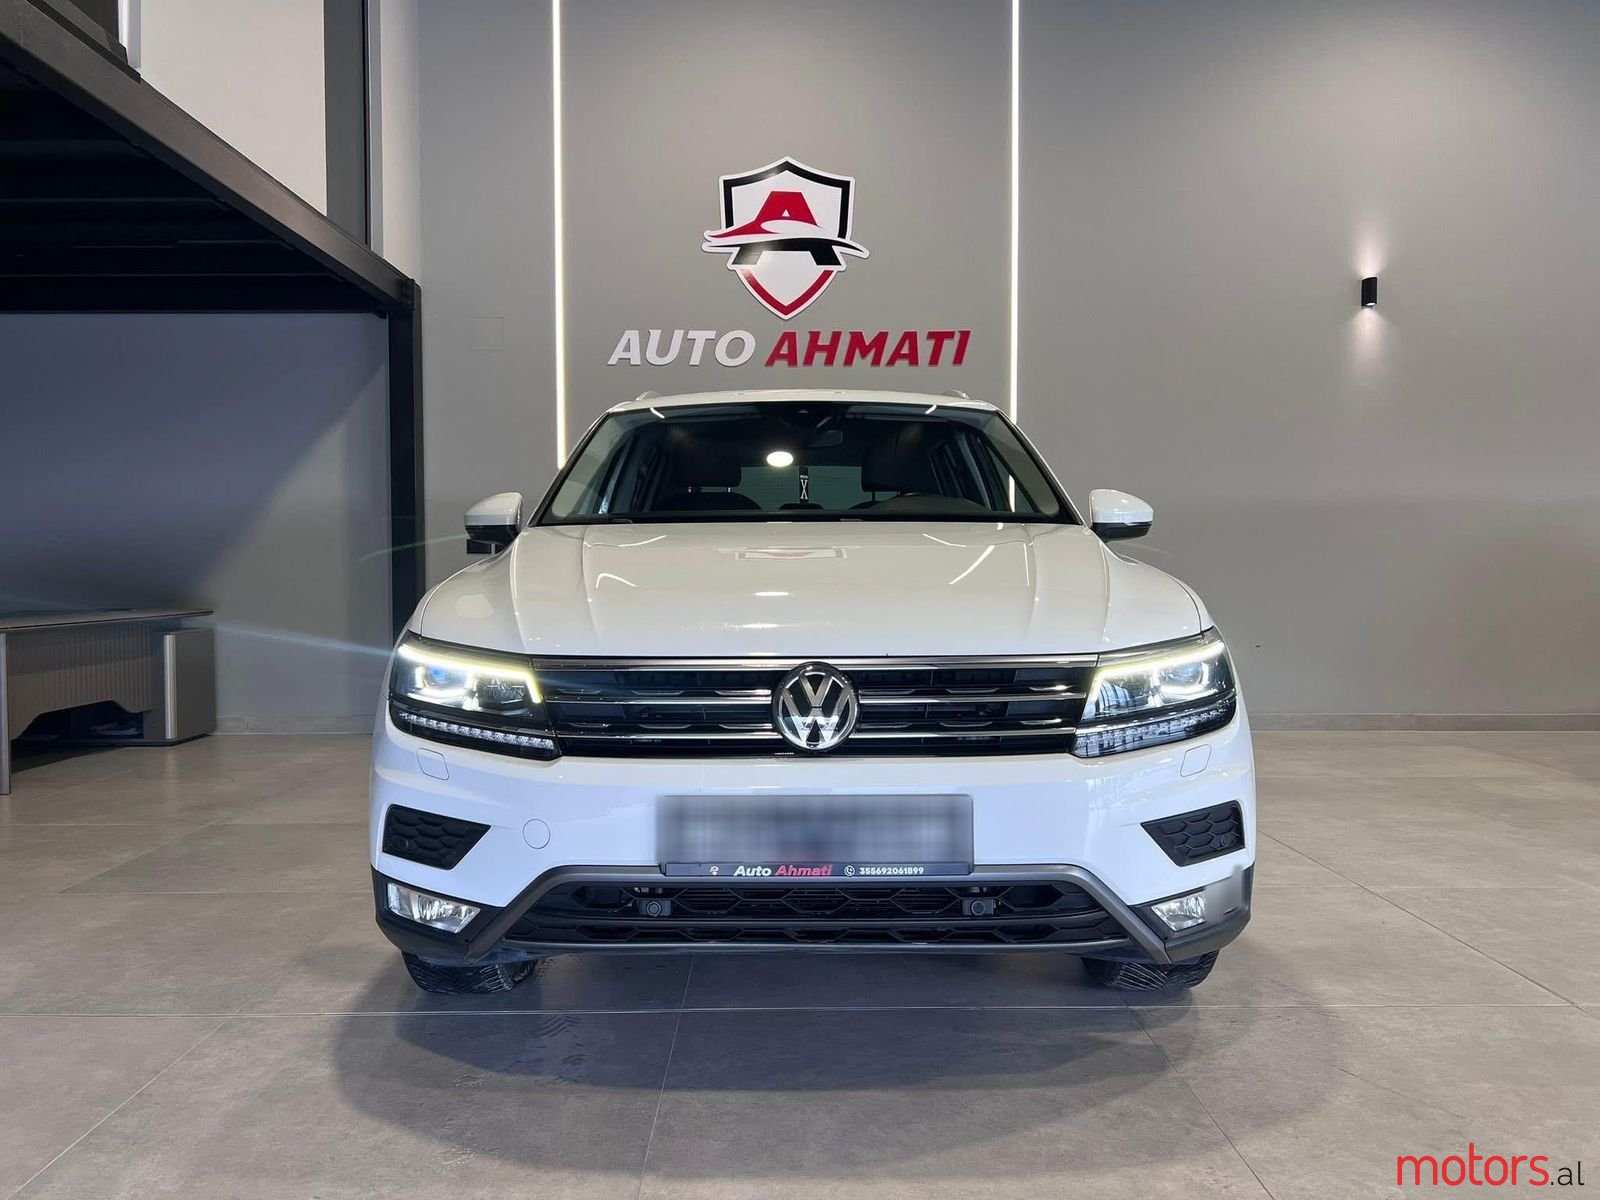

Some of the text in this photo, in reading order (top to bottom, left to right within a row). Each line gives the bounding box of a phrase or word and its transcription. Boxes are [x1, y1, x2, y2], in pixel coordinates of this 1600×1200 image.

[607, 329, 972, 368] AUTO AHMATI
[779, 672, 852, 745] VW
[733, 865, 772, 877] Auto
[775, 864, 834, 877] Ahmati
